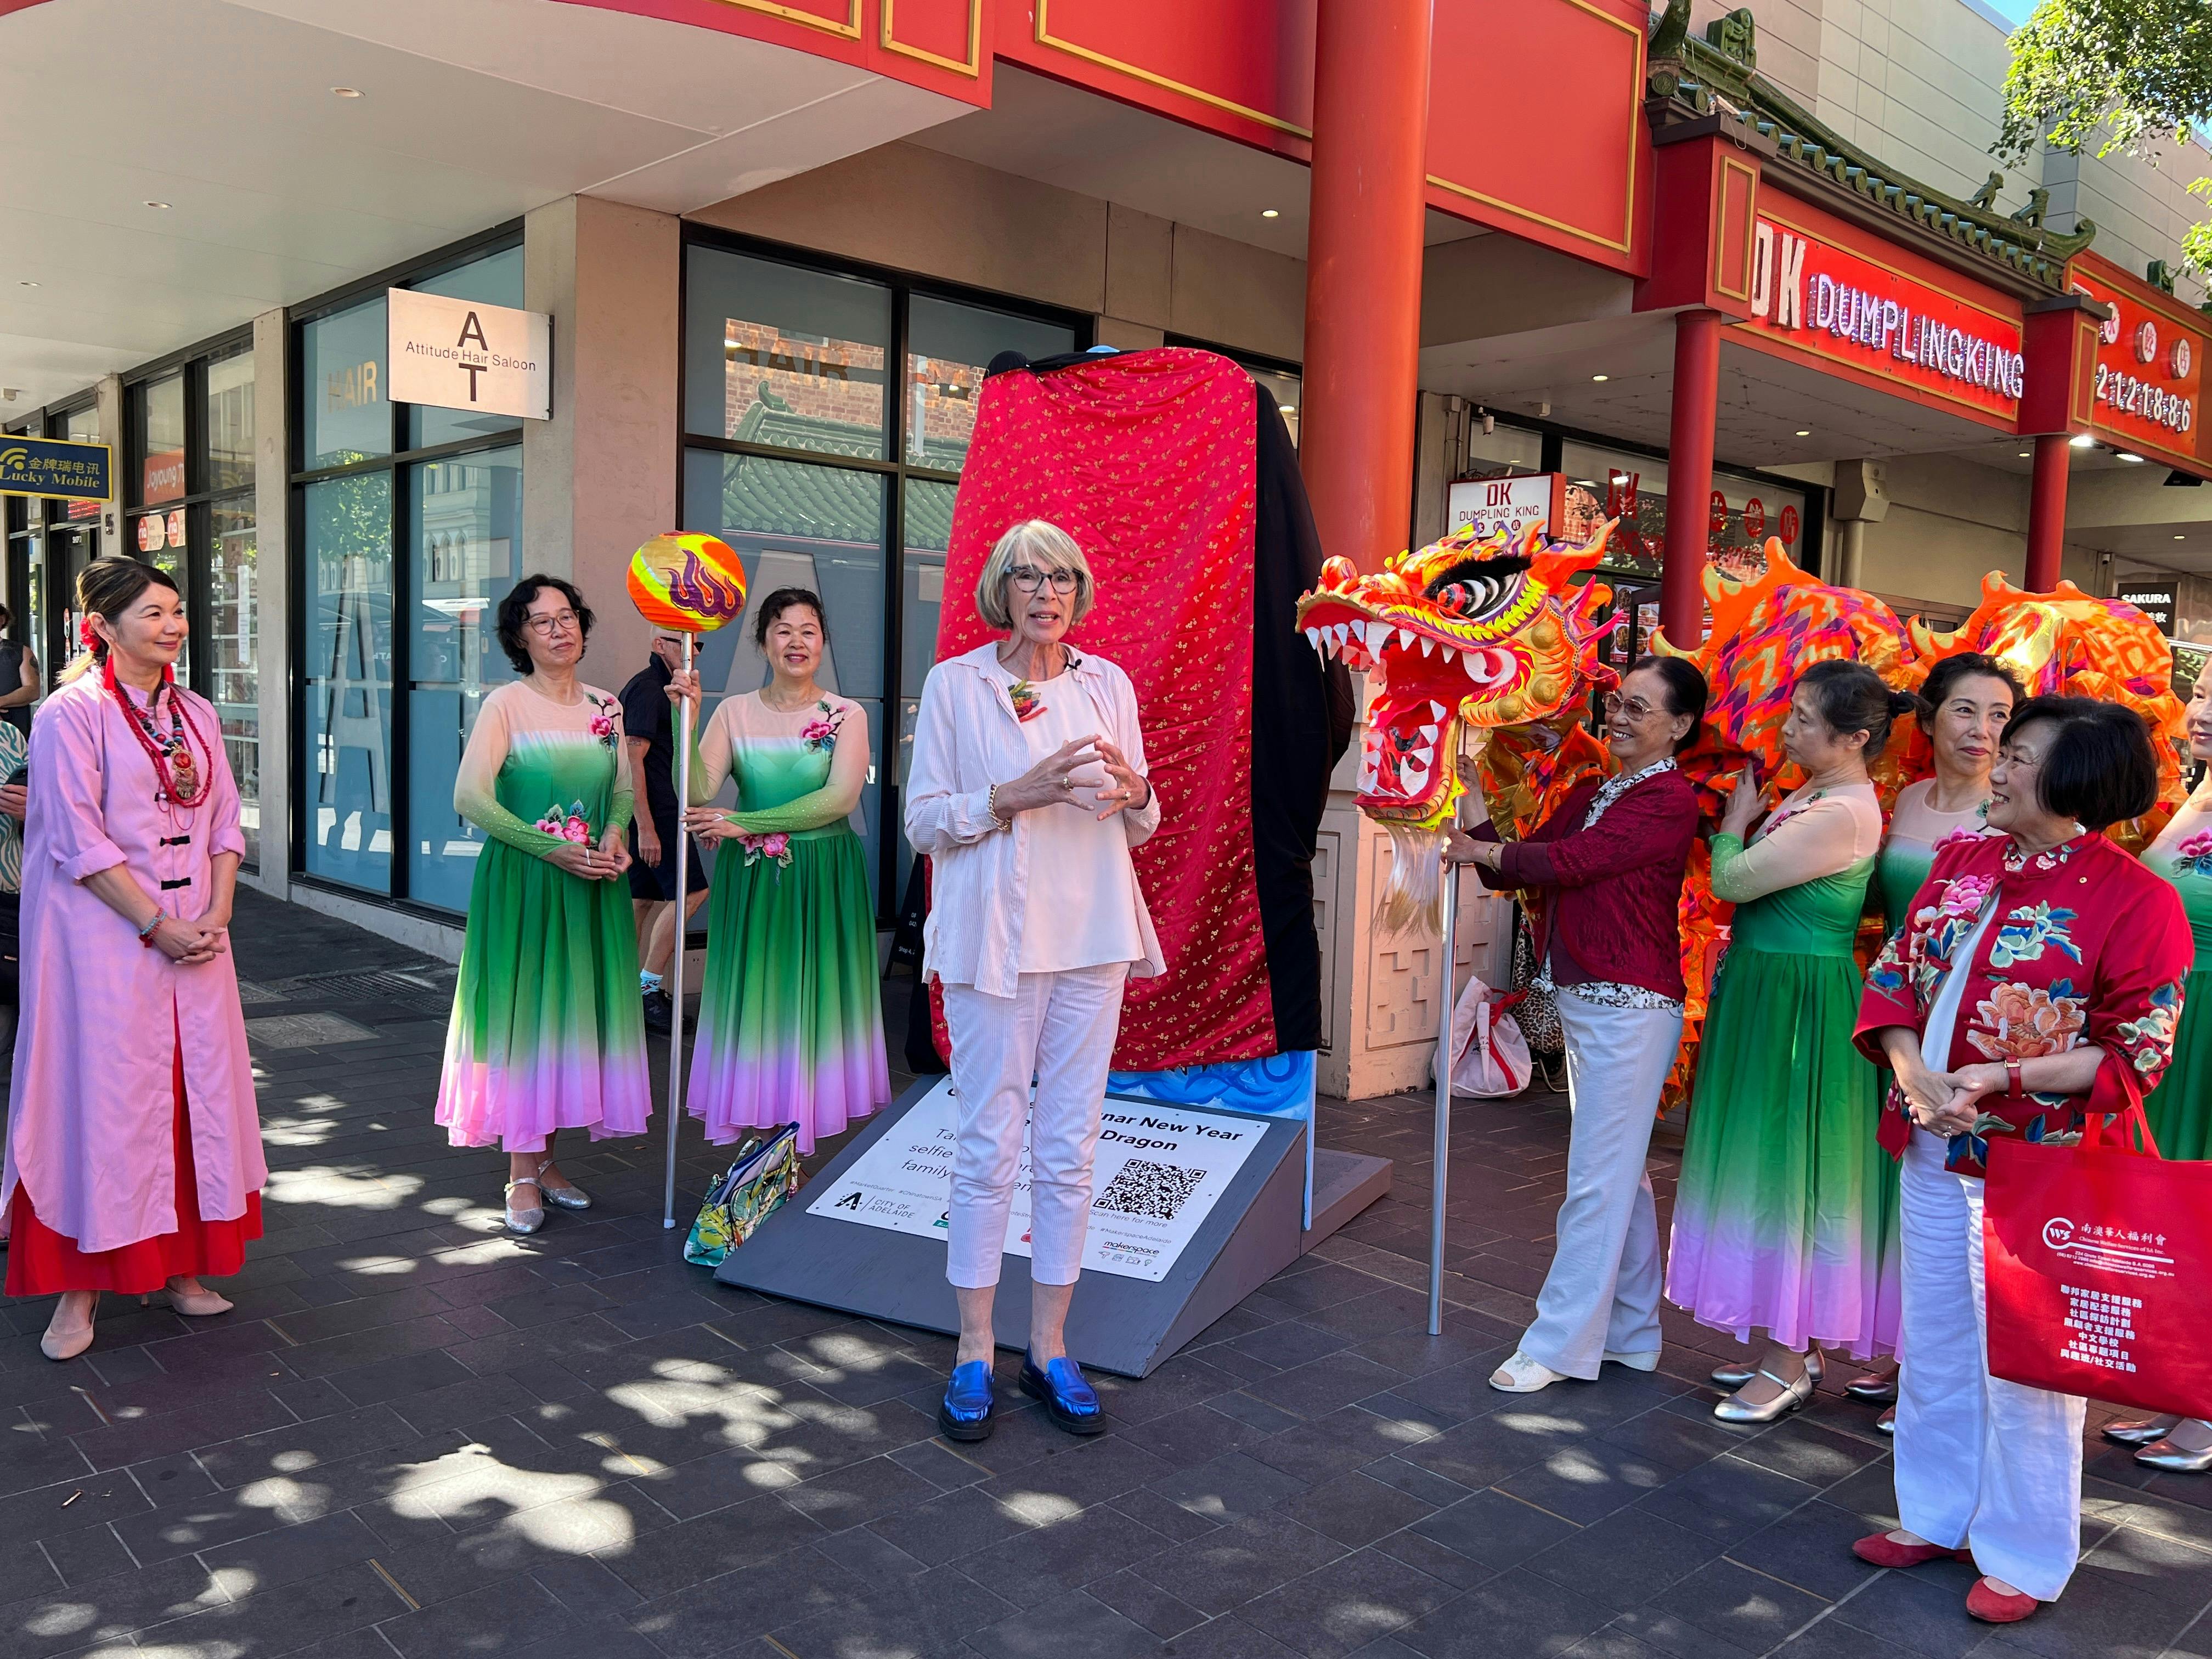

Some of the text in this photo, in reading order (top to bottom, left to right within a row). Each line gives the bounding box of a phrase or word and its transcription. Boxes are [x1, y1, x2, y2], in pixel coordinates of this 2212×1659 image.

[1752, 221, 1806, 329] DK
[457, 311, 488, 351] A
[405, 341, 536, 371] Attitude Hair Saloon
[328, 360, 377, 414] HAIR
[459, 362, 488, 402] T
[0, 464, 100, 488] Lucky Mobile
[28, 457, 100, 475] 金牌瑞电讯
[147, 465, 177, 492] Joyoung
[1487, 482, 1513, 506] DK
[1459, 505, 1539, 521] DUMPLING KING
[2121, 594, 2171, 603] SAKURA
[1101, 1113, 1243, 1141] nar New Year
[909, 1144, 953, 1159] selfie
[1099, 1130, 1177, 1152] Dragon
[901, 1159, 952, 1179] family
[899, 1190, 942, 1201] #ChinatownSA
[868, 1205, 916, 1218] ADELAIDE
[1089, 1209, 1109, 1218] Scan
[1111, 1213, 1130, 1221] here
[1101, 1228, 1172, 1244] #MakerspaceAdelaide
[2081, 1223, 2167, 1246] 南澳華人福利會
[1103, 1241, 1160, 1254] makerspace
[2118, 1243, 2140, 1251] Services
